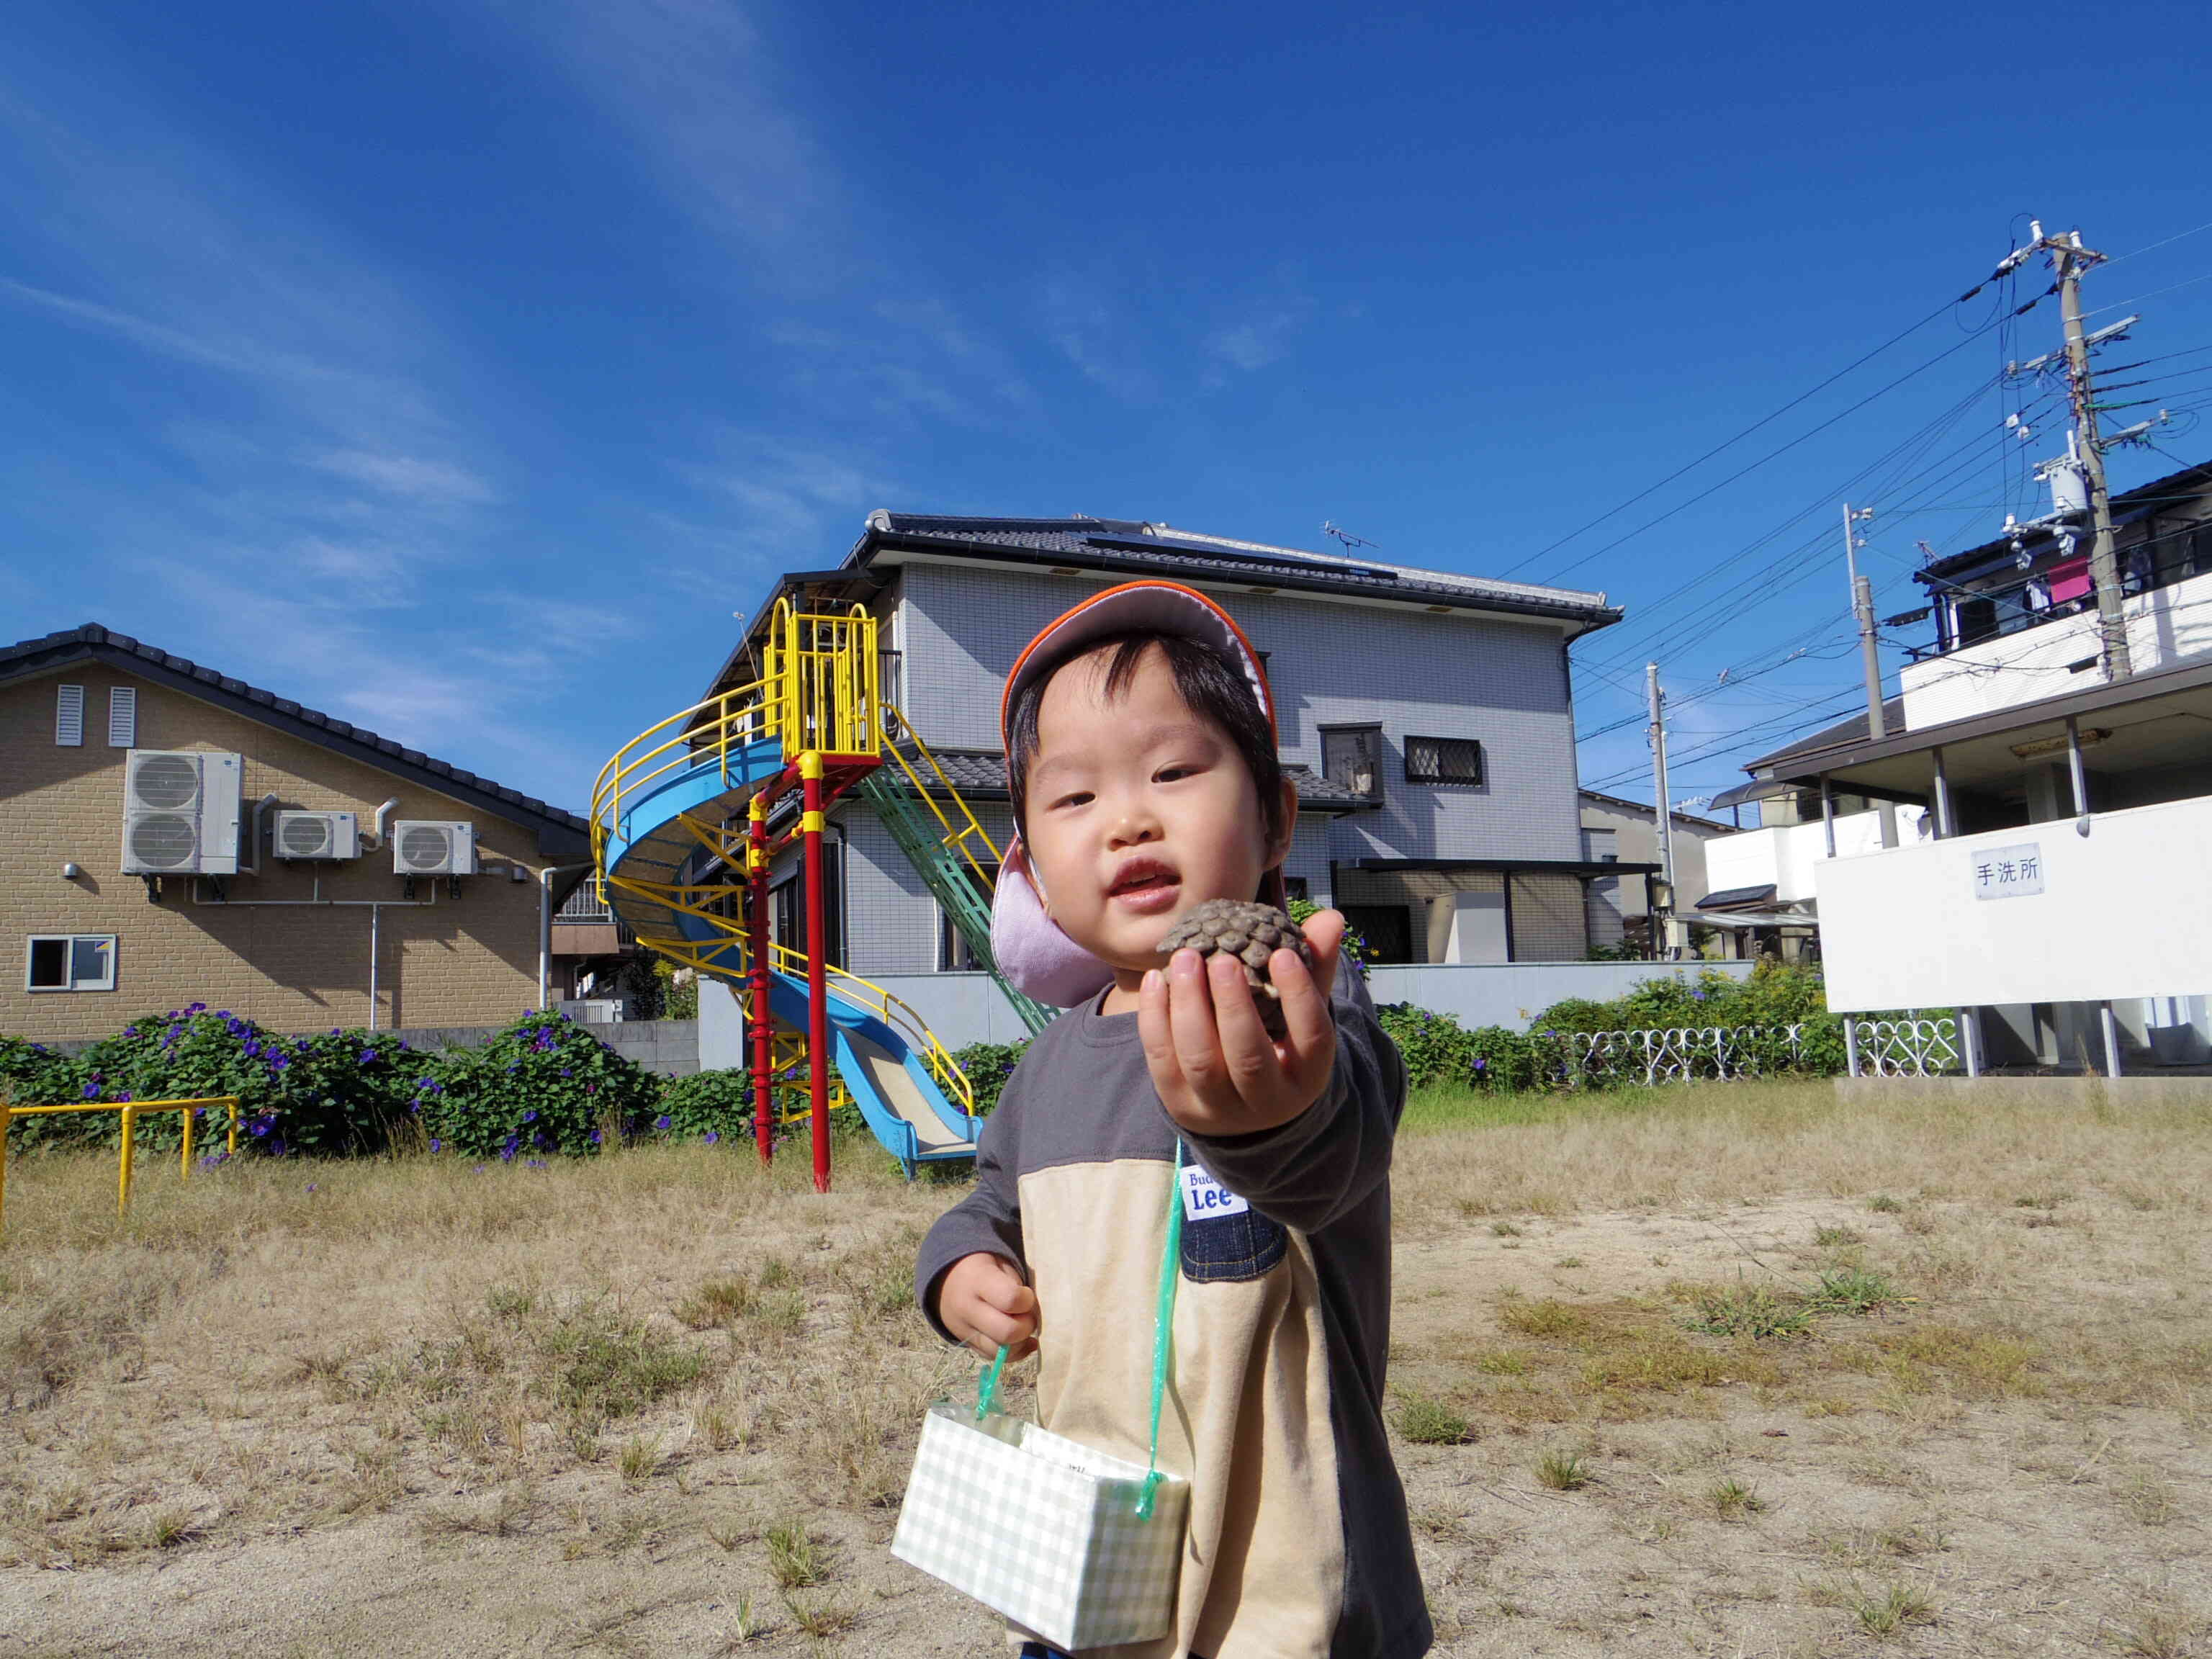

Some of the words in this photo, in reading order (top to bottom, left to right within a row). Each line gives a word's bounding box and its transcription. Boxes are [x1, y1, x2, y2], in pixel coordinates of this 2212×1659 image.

[1977, 858, 2038, 886] 手洗所
[1192, 1188, 1232, 1210] Lee
